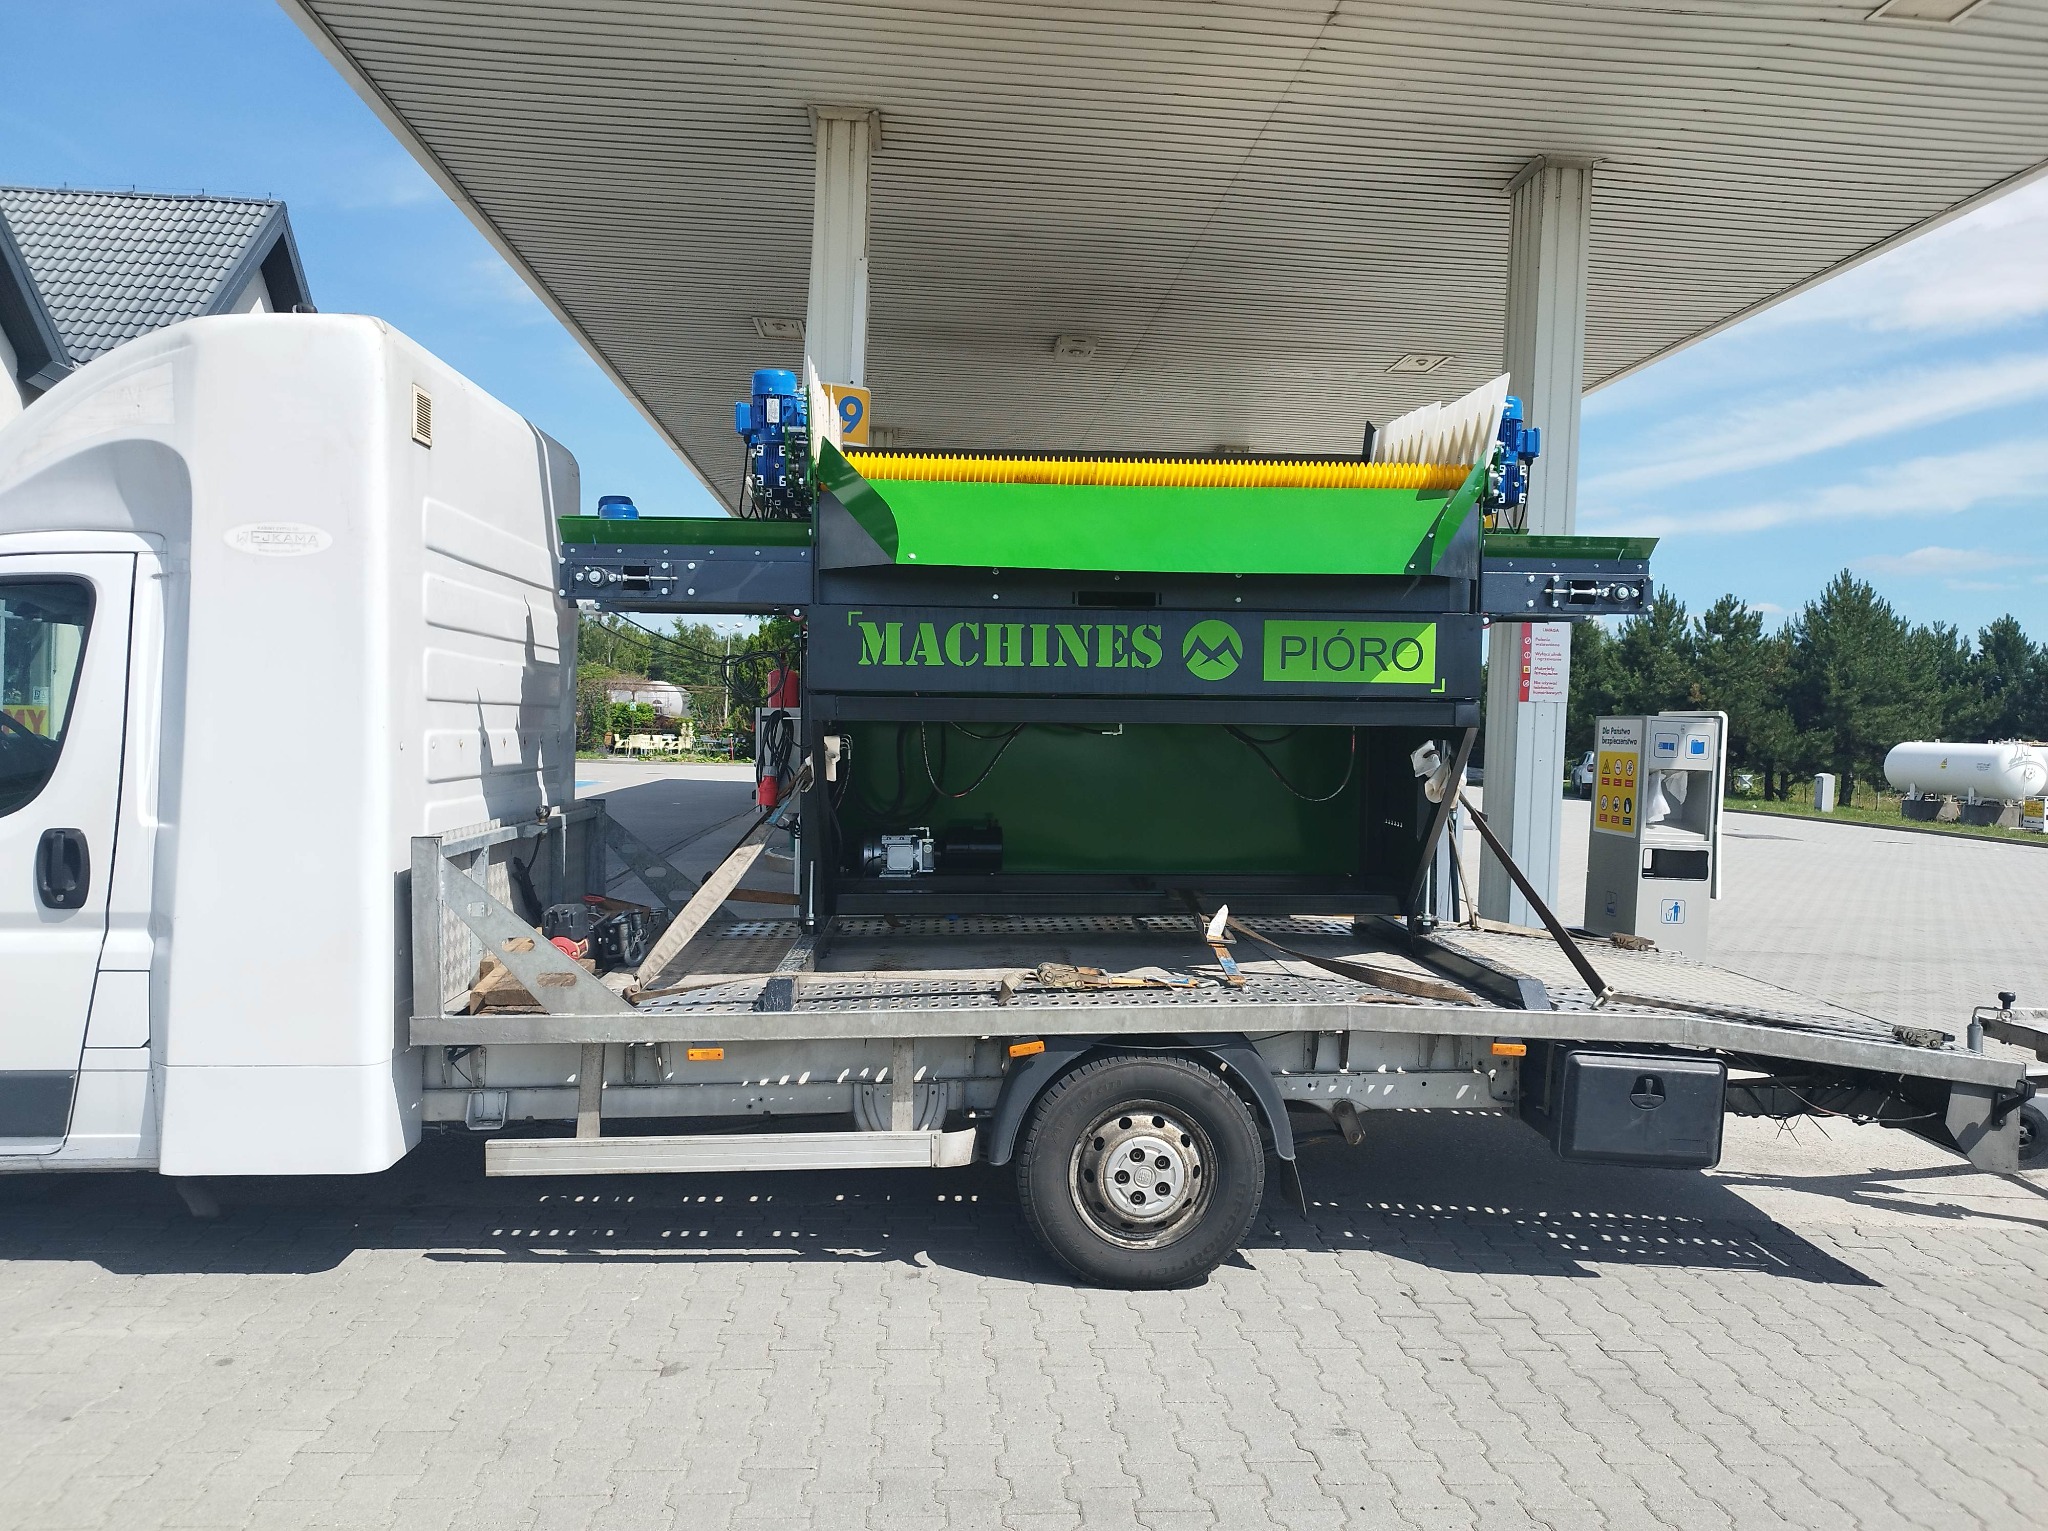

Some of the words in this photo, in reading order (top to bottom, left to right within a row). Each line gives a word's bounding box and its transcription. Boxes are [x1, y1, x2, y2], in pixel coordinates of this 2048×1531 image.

[839, 396, 864, 434] 9
[857, 622, 1163, 668] MACHINES
[1280, 628, 1424, 672] PIÓRO
[1602, 726, 1610, 734] Dla
